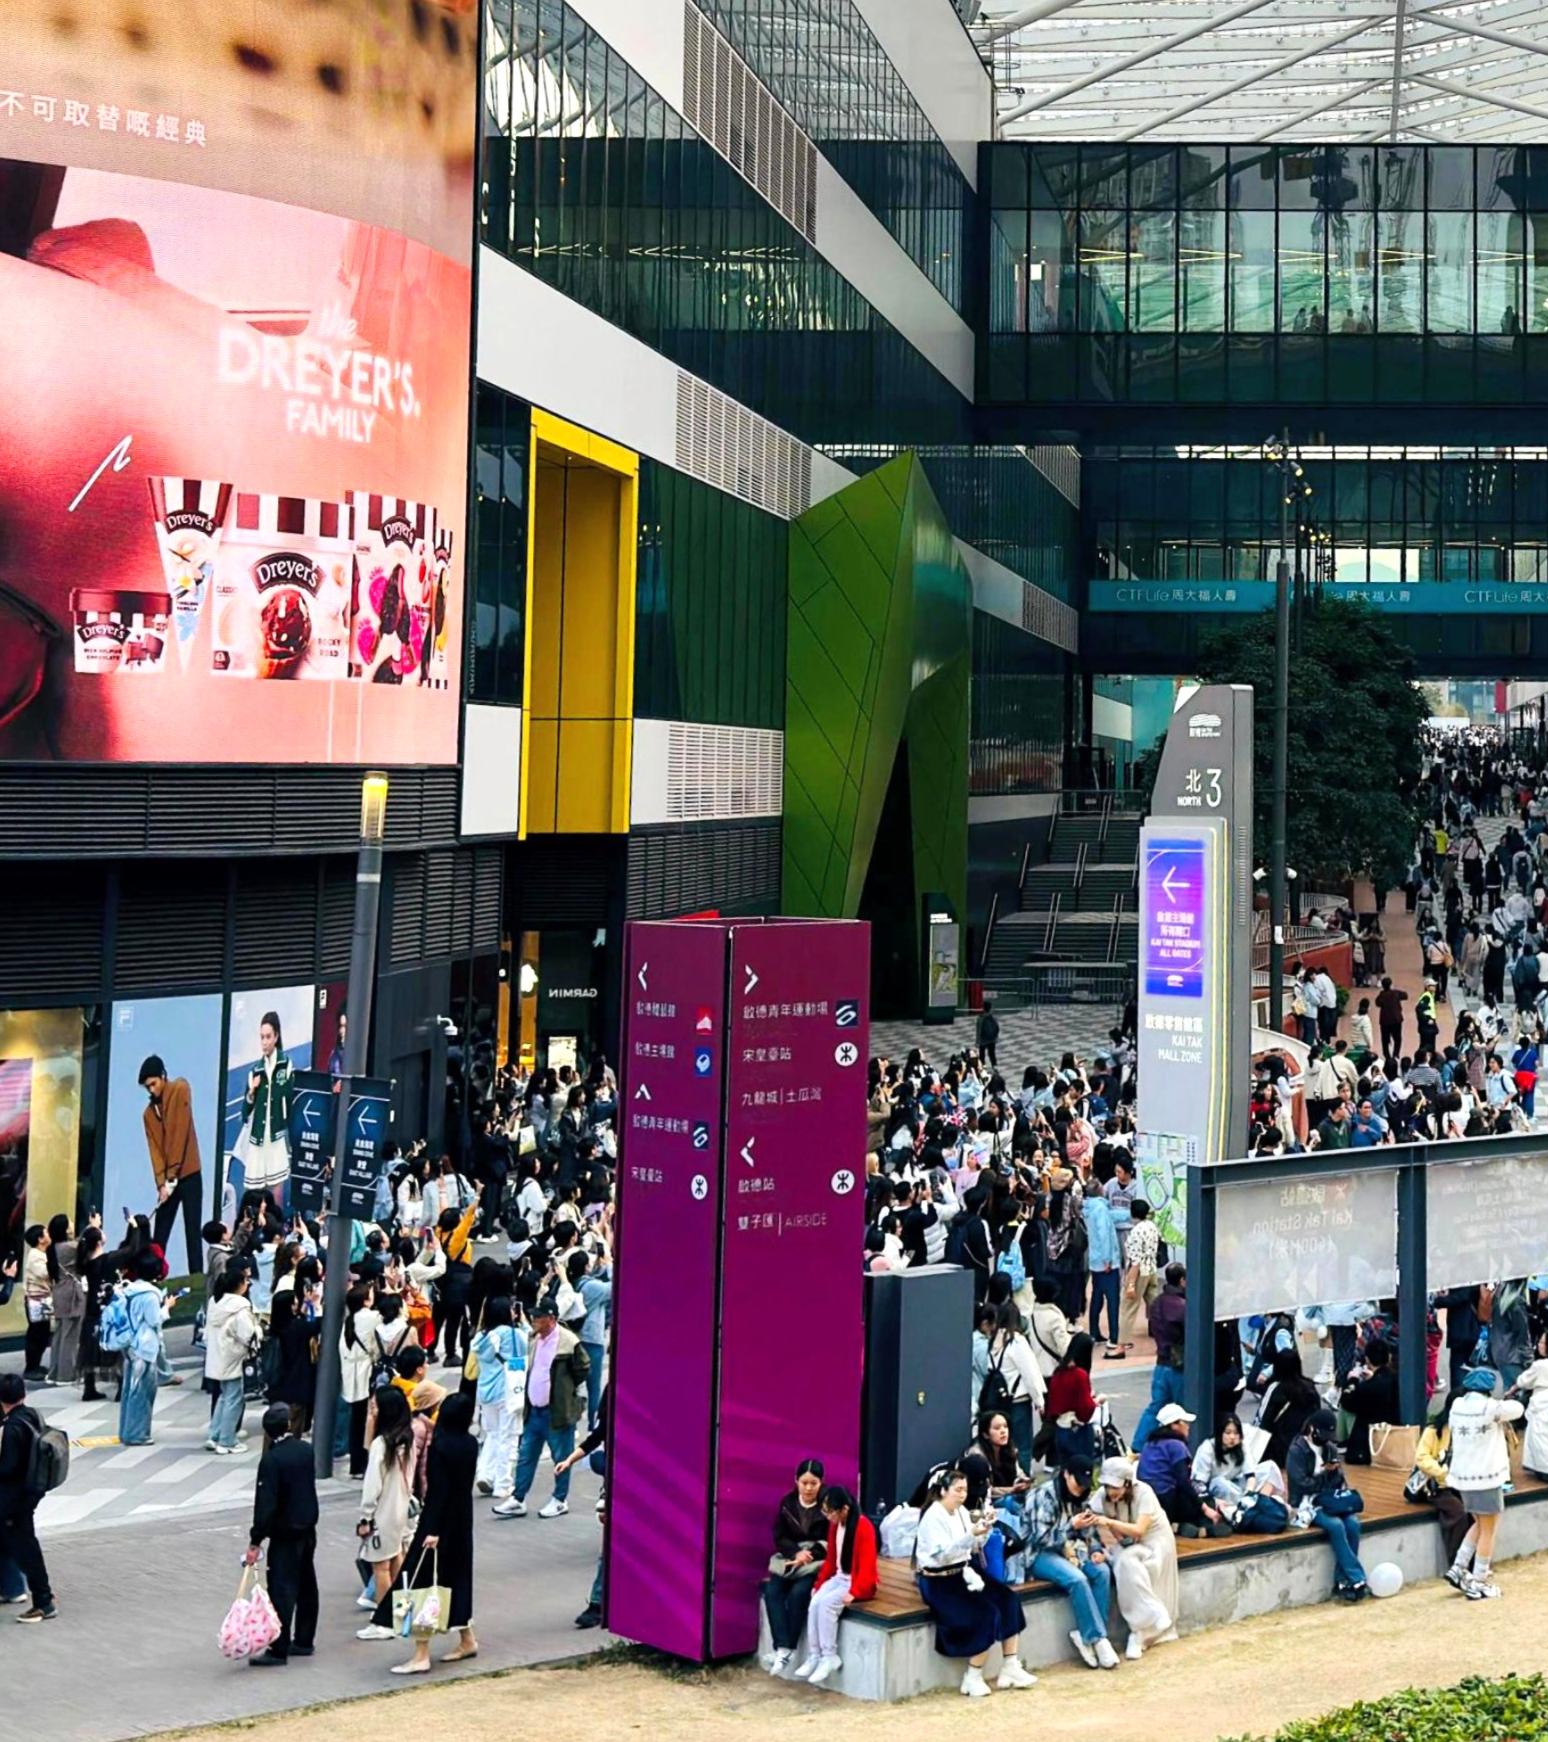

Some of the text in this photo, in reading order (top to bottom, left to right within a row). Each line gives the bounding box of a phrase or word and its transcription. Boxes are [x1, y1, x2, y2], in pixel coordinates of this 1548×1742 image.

[0, 89, 208, 148] 不可取替嘅經典
[287, 400, 376, 443] FAMILY
[168, 513, 214, 532] Dreyer's
[258, 560, 318, 587] Dreyer's
[82, 623, 125, 640] Dreyer's
[1186, 769, 1222, 807] 北 3
[1177, 796, 1201, 807] NORTH
[1171, 1034, 1203, 1048] KAI TAK
[1158, 1048, 1203, 1063] MALL ZONE
[785, 1214, 828, 1228] AIRSIDE
